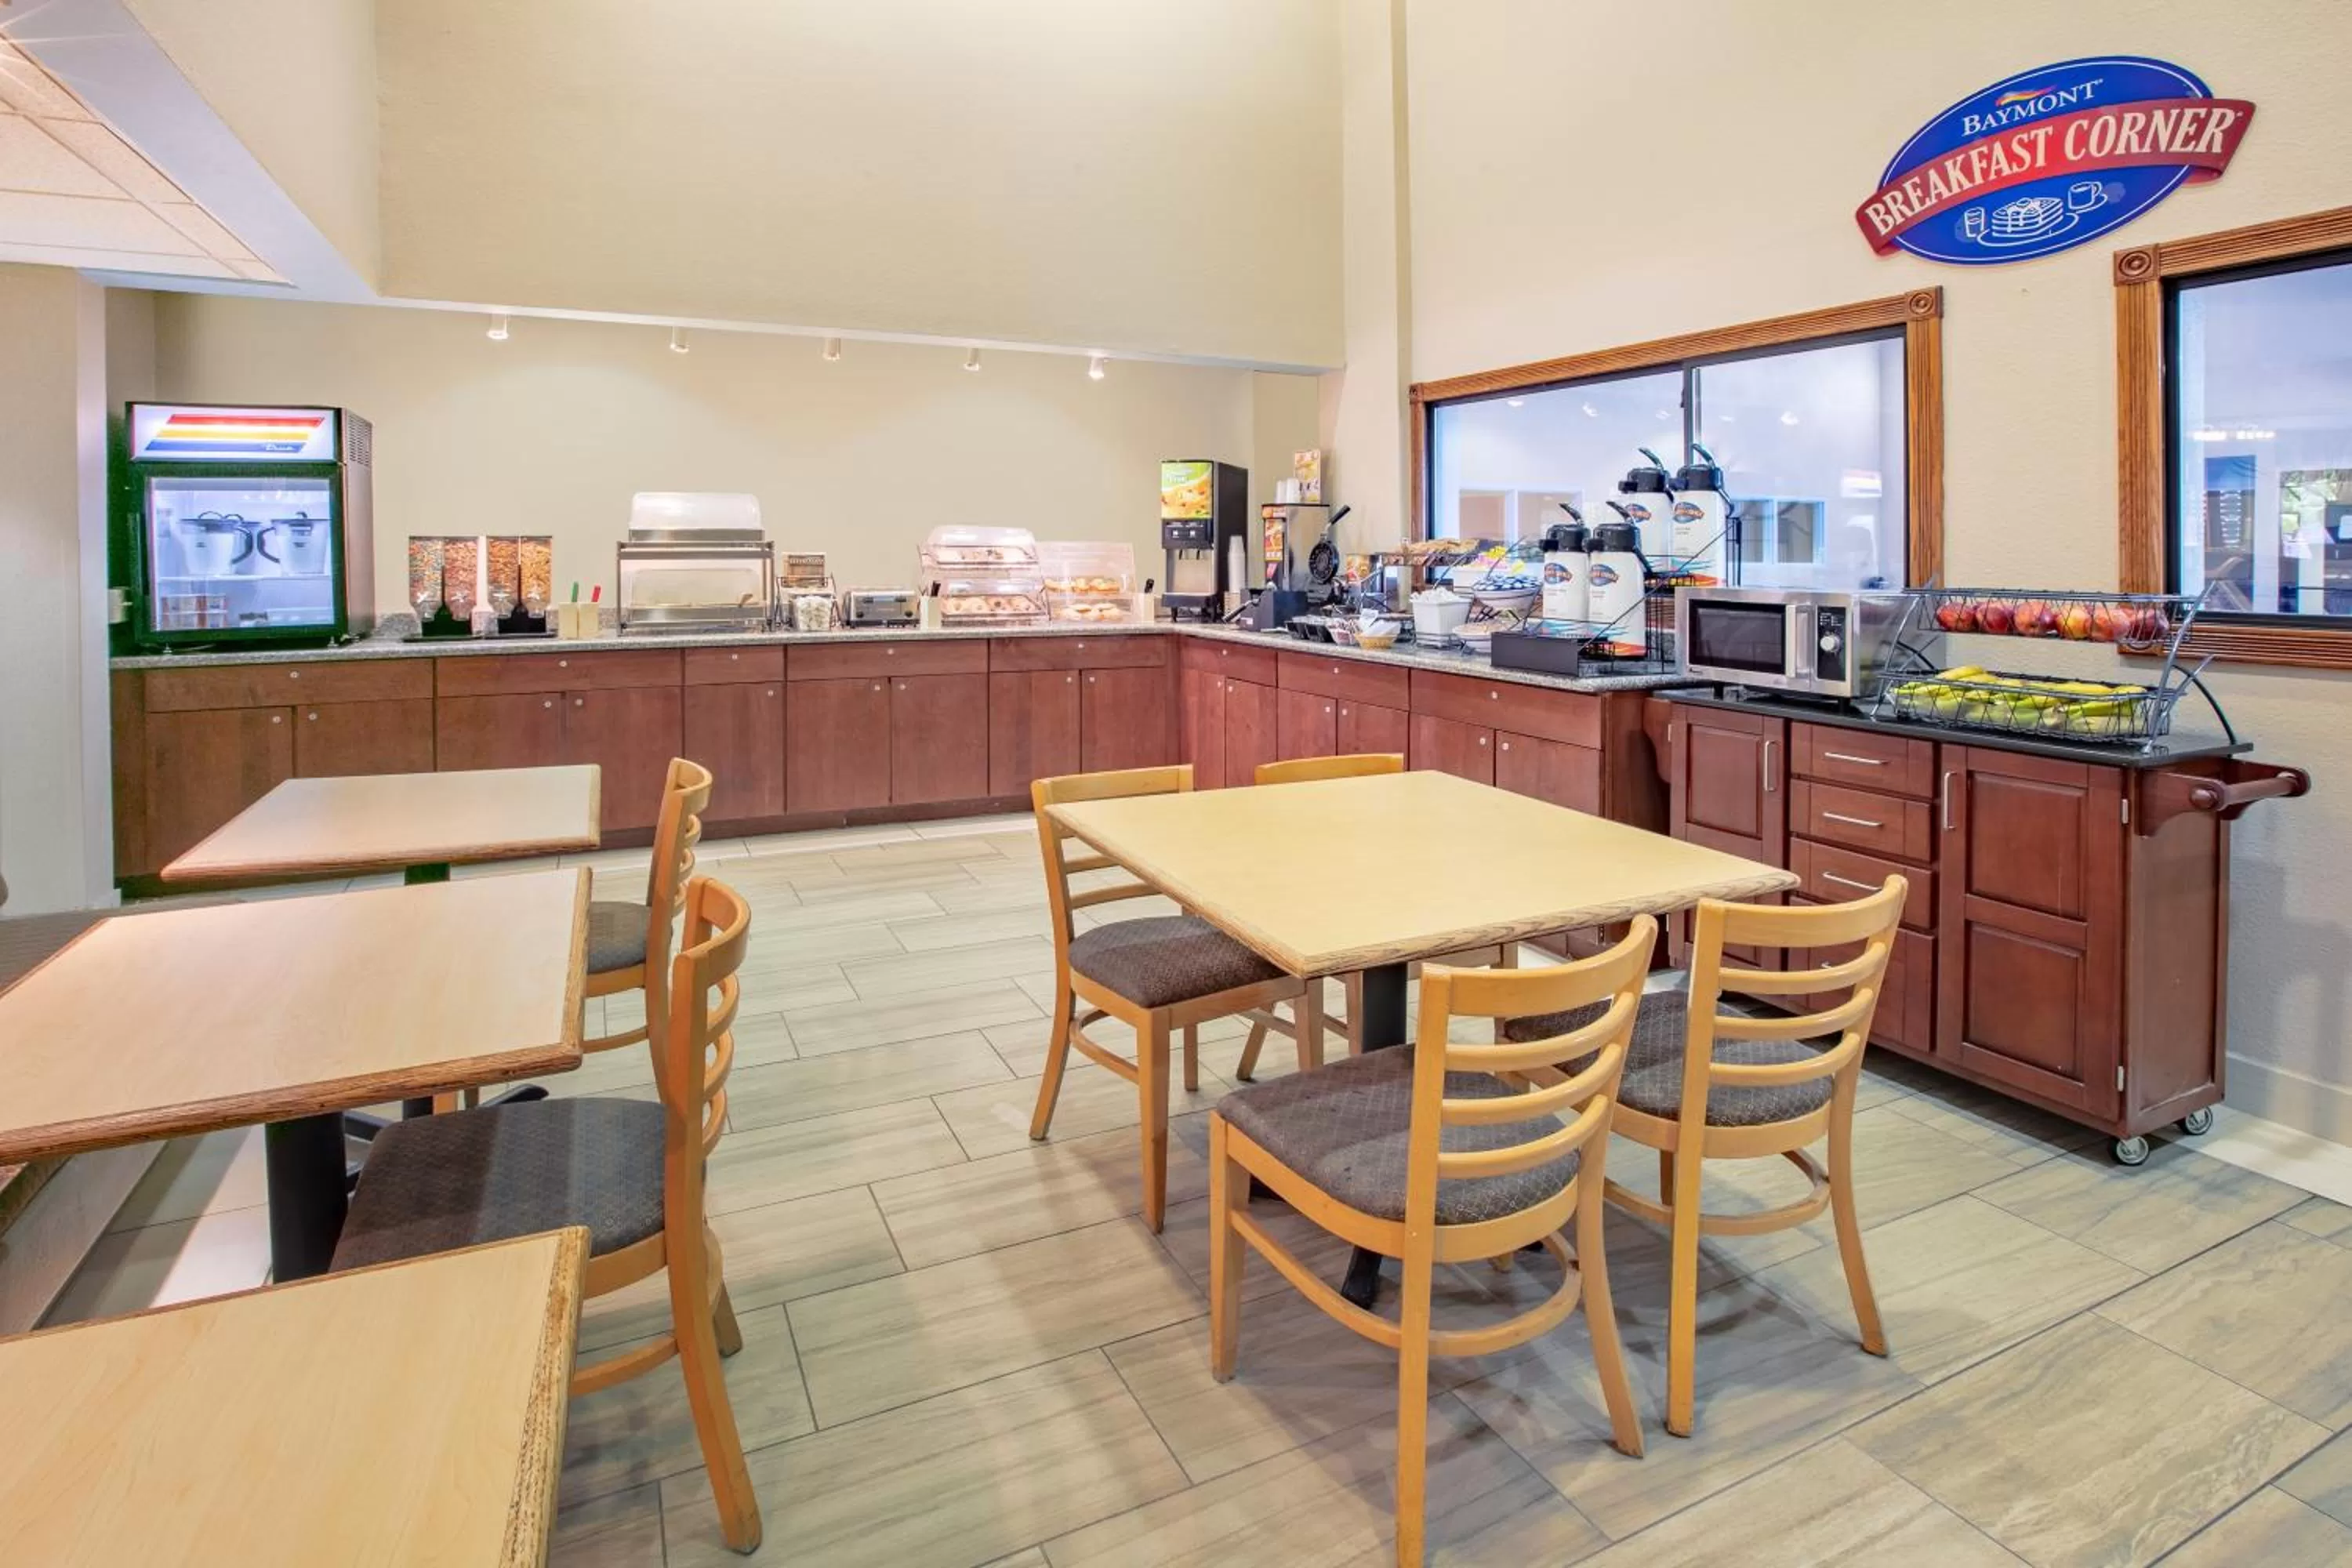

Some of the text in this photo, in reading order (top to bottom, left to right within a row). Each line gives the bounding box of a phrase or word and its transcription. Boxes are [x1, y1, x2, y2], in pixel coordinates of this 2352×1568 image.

[1962, 81, 2096, 136] BAYMONT
[1864, 107, 2234, 237] BREAKFAST CORNER
